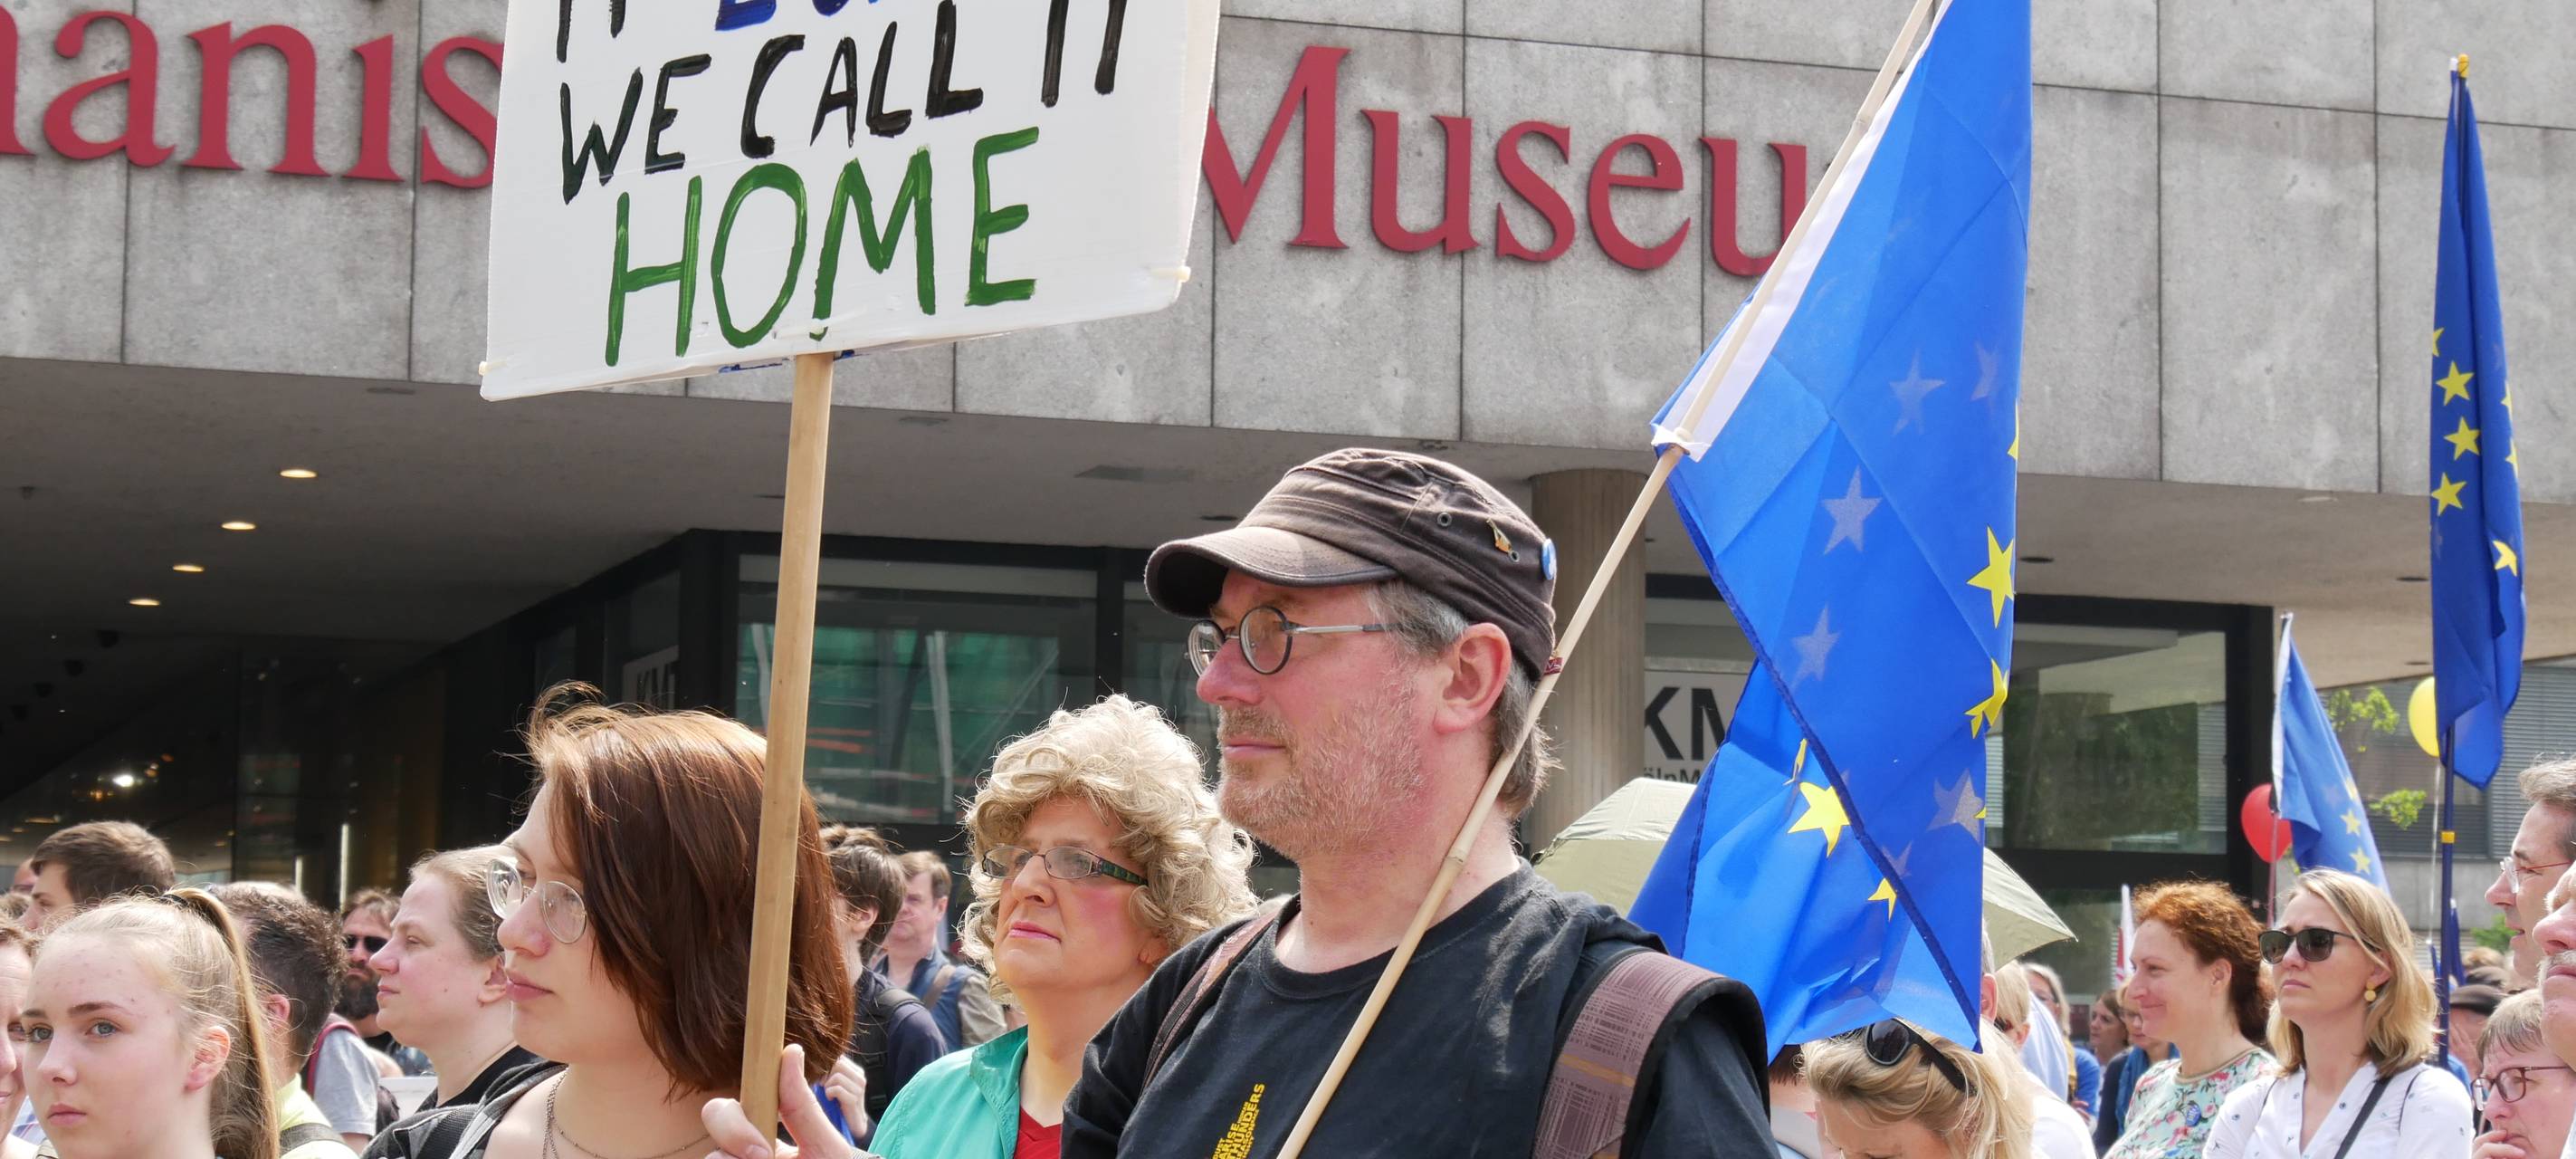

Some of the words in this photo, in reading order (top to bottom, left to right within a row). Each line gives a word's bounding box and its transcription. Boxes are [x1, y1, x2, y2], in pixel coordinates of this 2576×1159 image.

[558, 54, 711, 205] WE
[740, 0, 984, 158] CALL
[606, 127, 1038, 367] HOME
[1218, 1123, 1240, 1159] ARISE
[1226, 1083, 1265, 1159] THUNDERS
[1236, 1122, 1255, 1159] EASON
